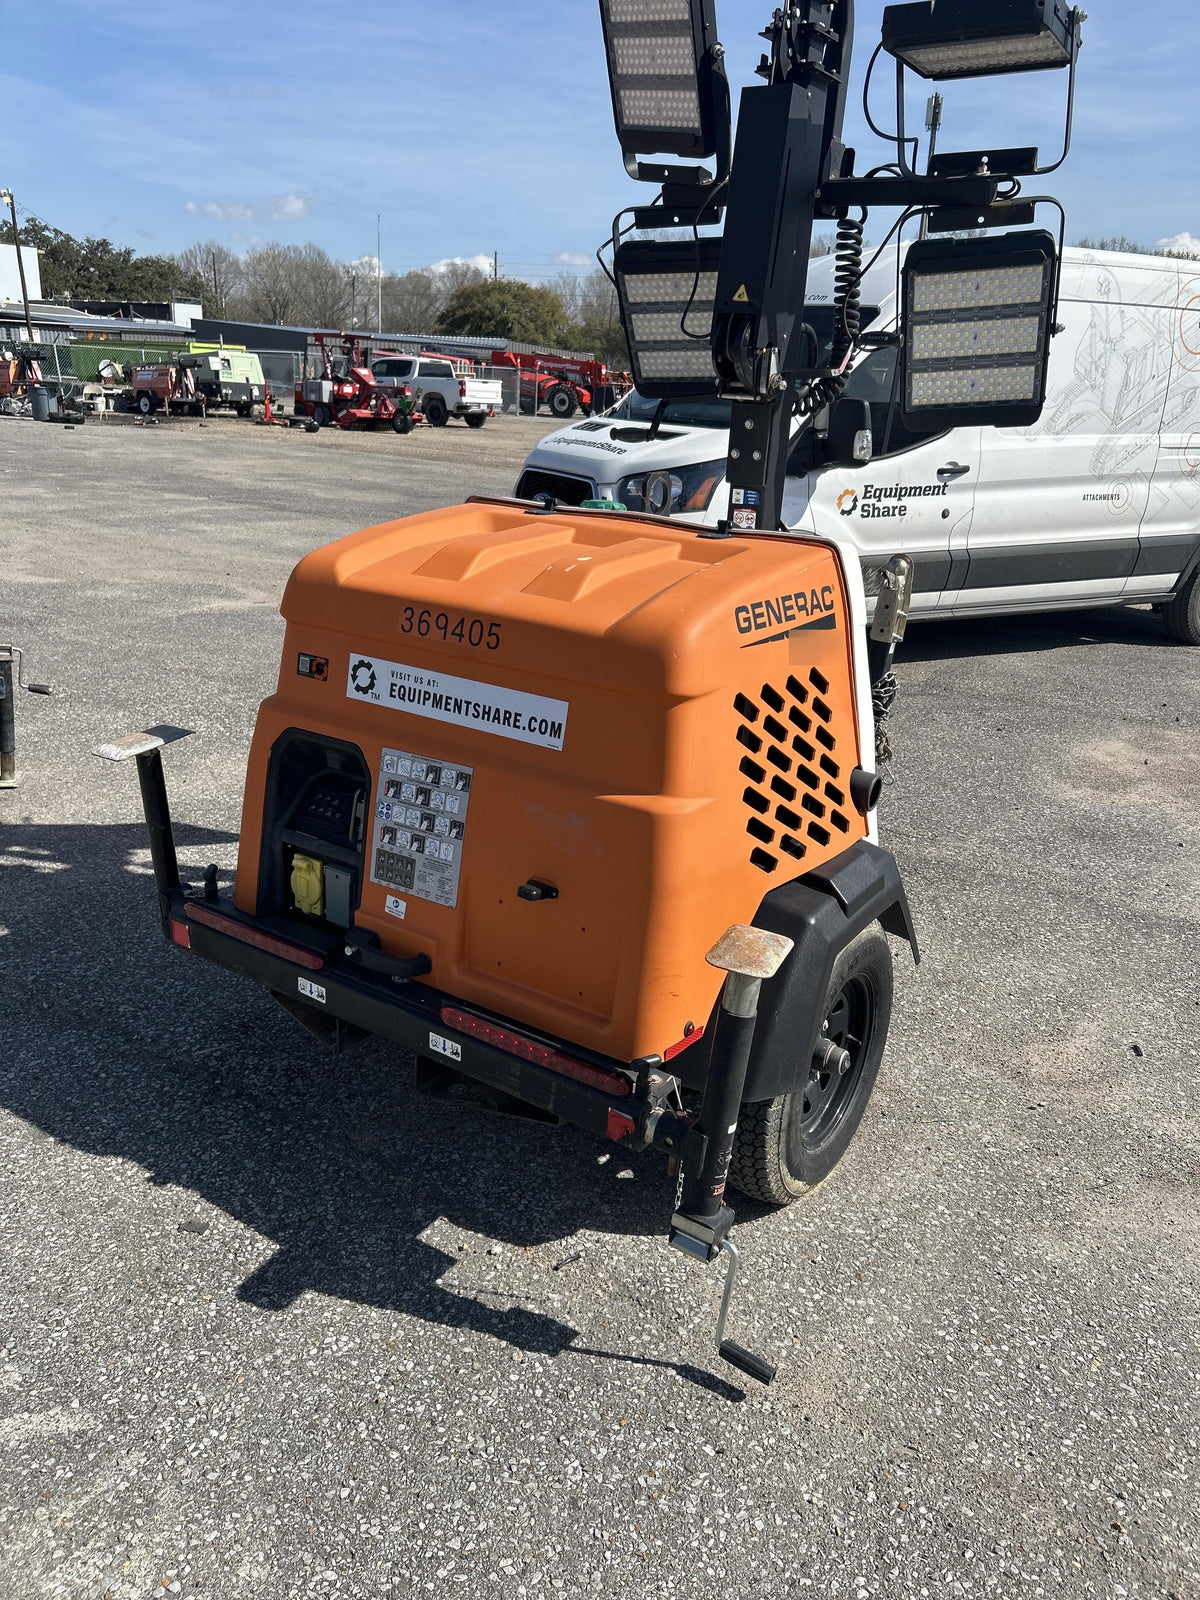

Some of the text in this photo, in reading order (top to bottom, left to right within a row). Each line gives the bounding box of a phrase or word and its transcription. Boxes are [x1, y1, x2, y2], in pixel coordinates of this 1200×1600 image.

[862, 482, 949, 503] Equipment
[1082, 493, 1121, 501] ATTACHMENTS
[860, 503, 907, 519] Share
[734, 585, 835, 635] GENERAC
[400, 606, 502, 651] 369405
[390, 669, 440, 689] VISIT US AT:
[388, 682, 563, 740] EQUIPMENTSHARE.COM
